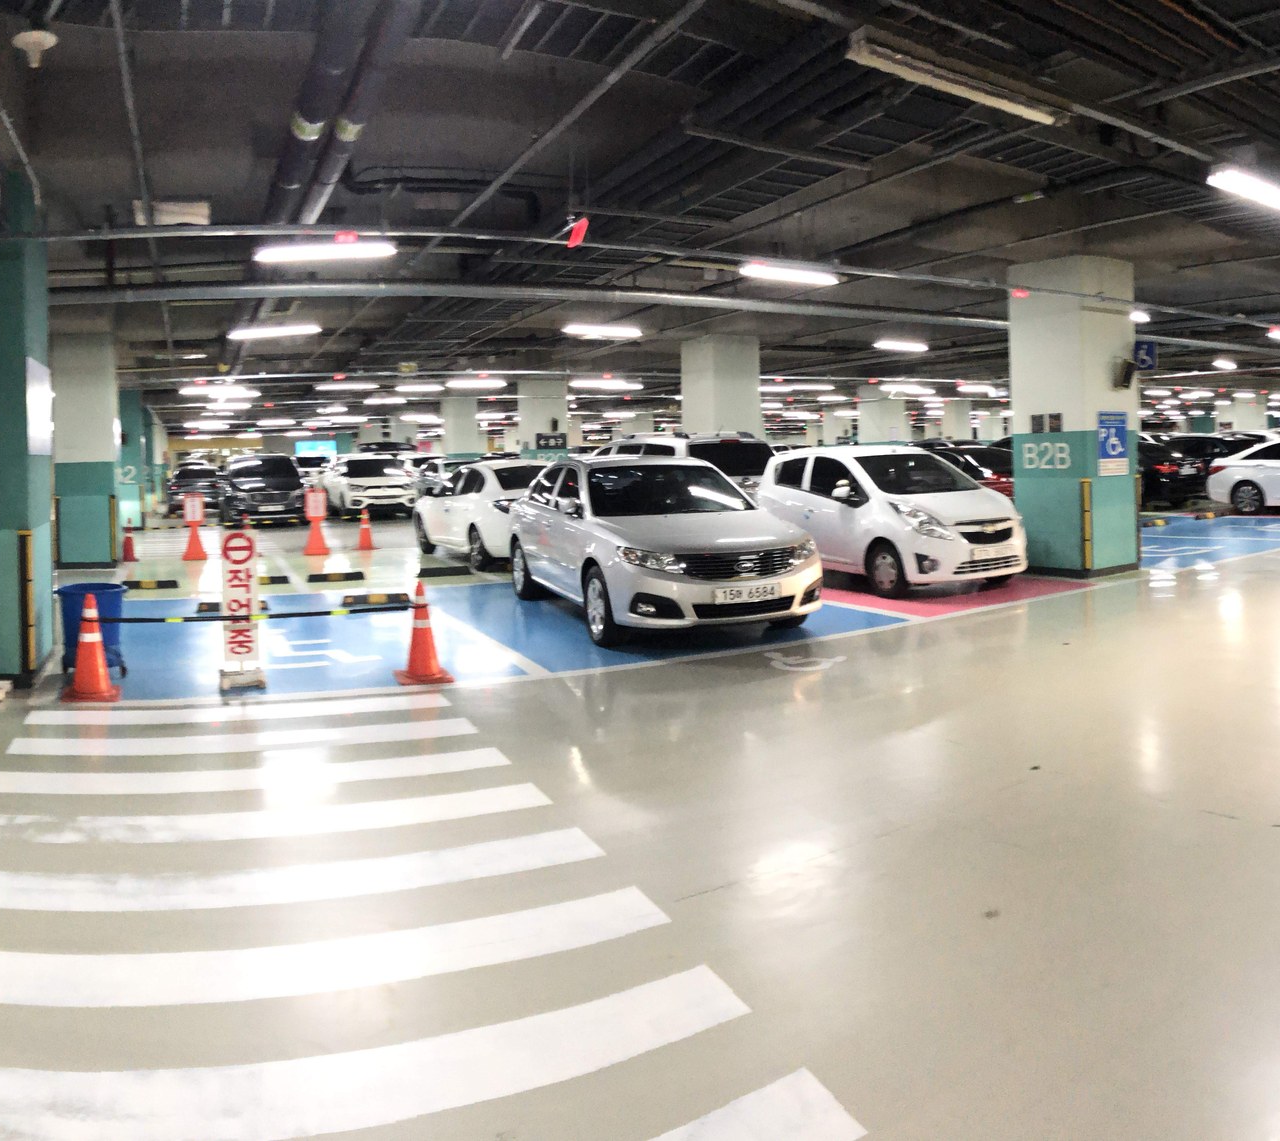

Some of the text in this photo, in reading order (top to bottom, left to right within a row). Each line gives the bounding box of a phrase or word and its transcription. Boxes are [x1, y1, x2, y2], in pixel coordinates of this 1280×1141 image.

[1022, 441, 1072, 470] B2B
[748, 587, 775, 599] 6584
[225, 567, 255, 656] 작업중
